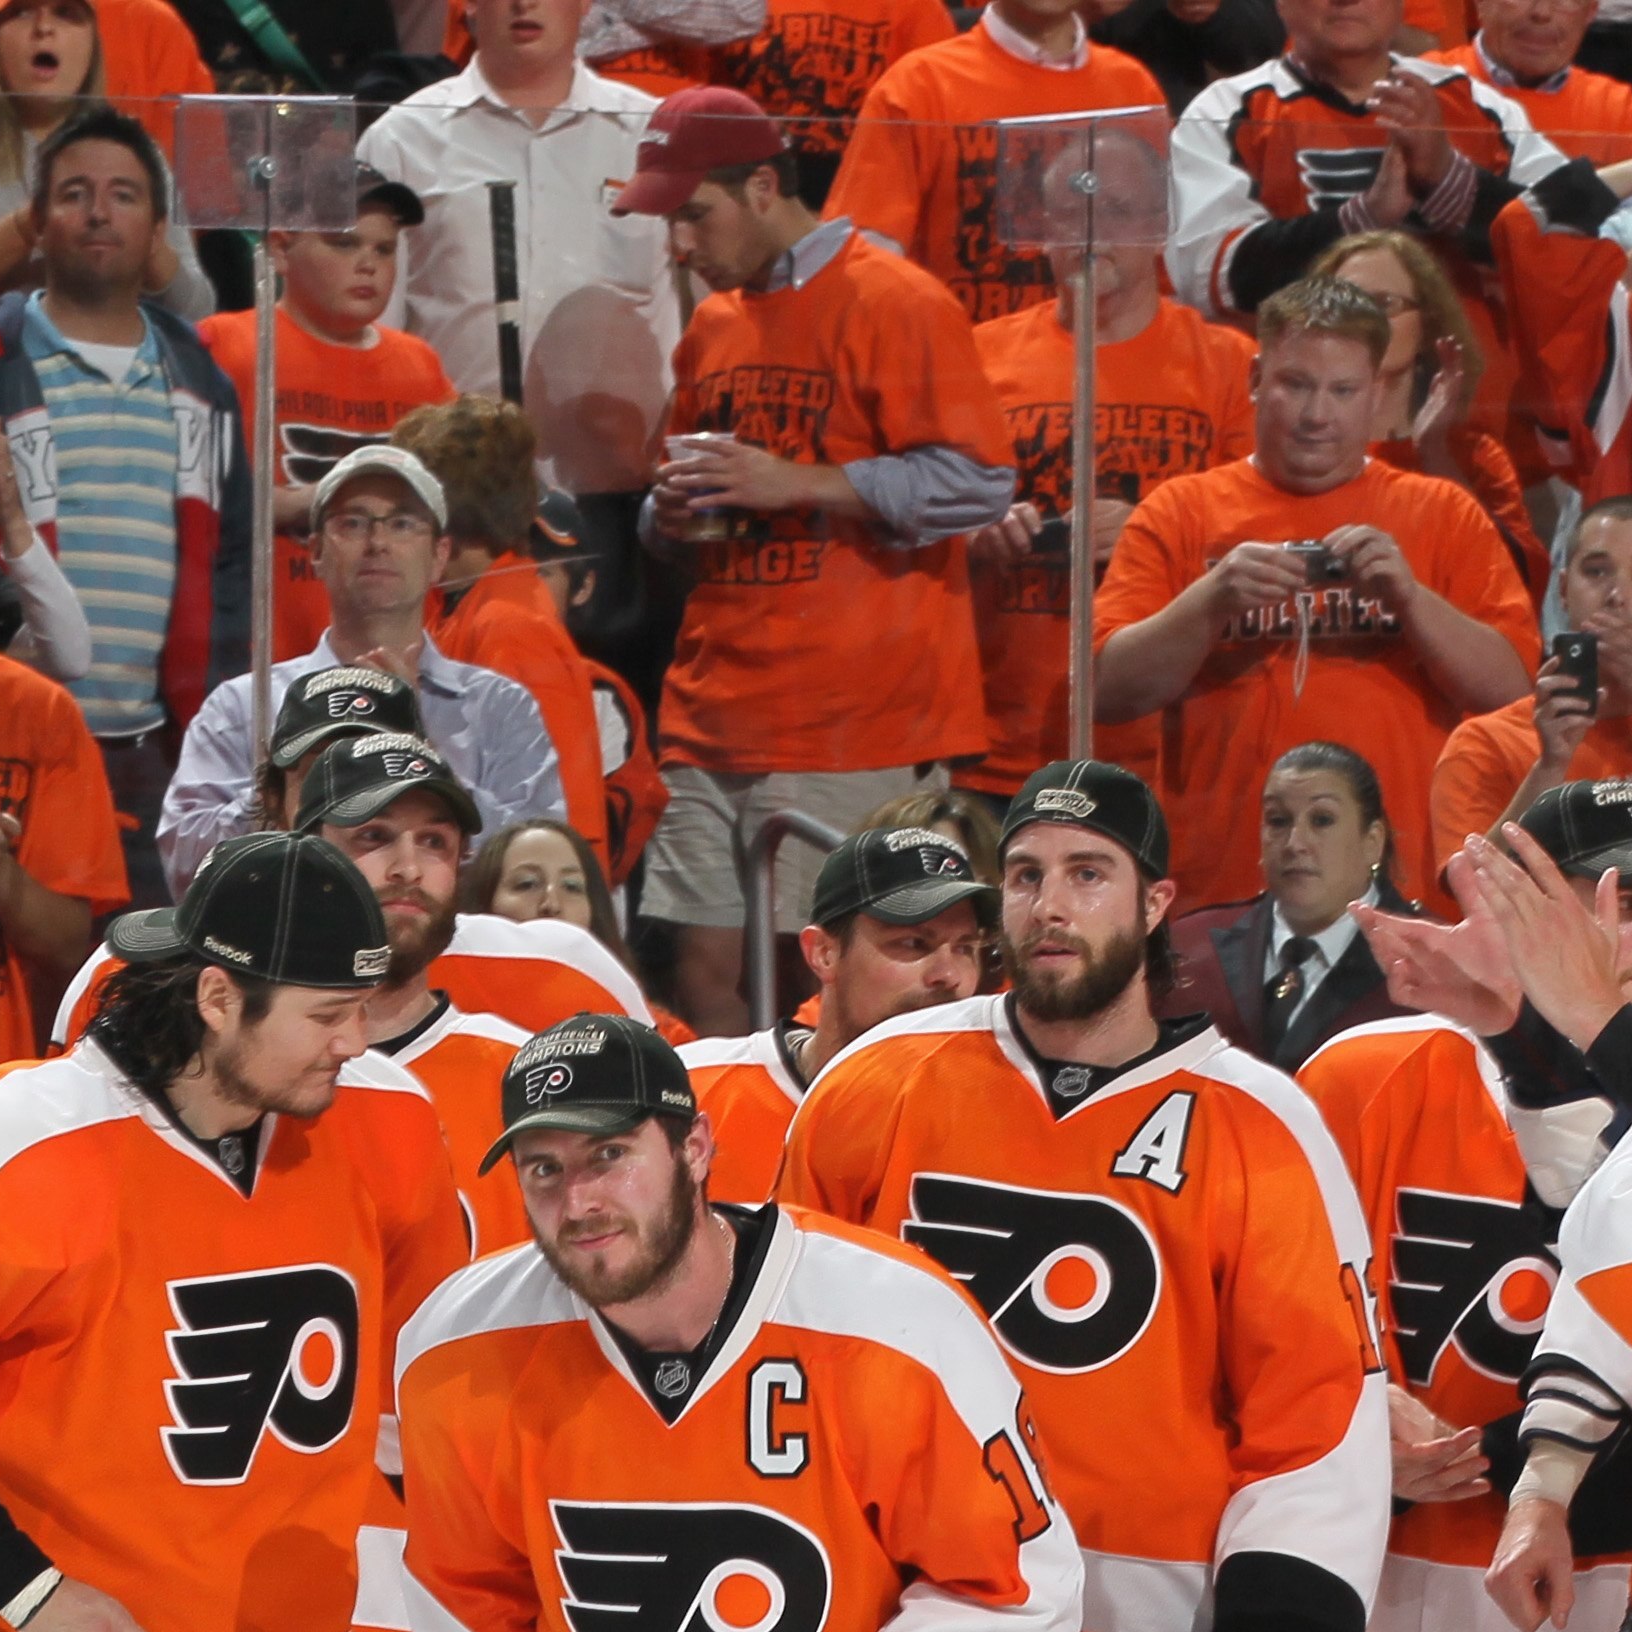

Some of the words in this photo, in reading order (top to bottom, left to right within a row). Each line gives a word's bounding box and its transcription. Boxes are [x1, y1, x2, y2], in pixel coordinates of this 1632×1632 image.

[303, 676, 395, 702] CHAMPIONS
[203, 935, 254, 966] Reebok
[1110, 1089, 1195, 1194] A
[745, 1357, 809, 1479] C
